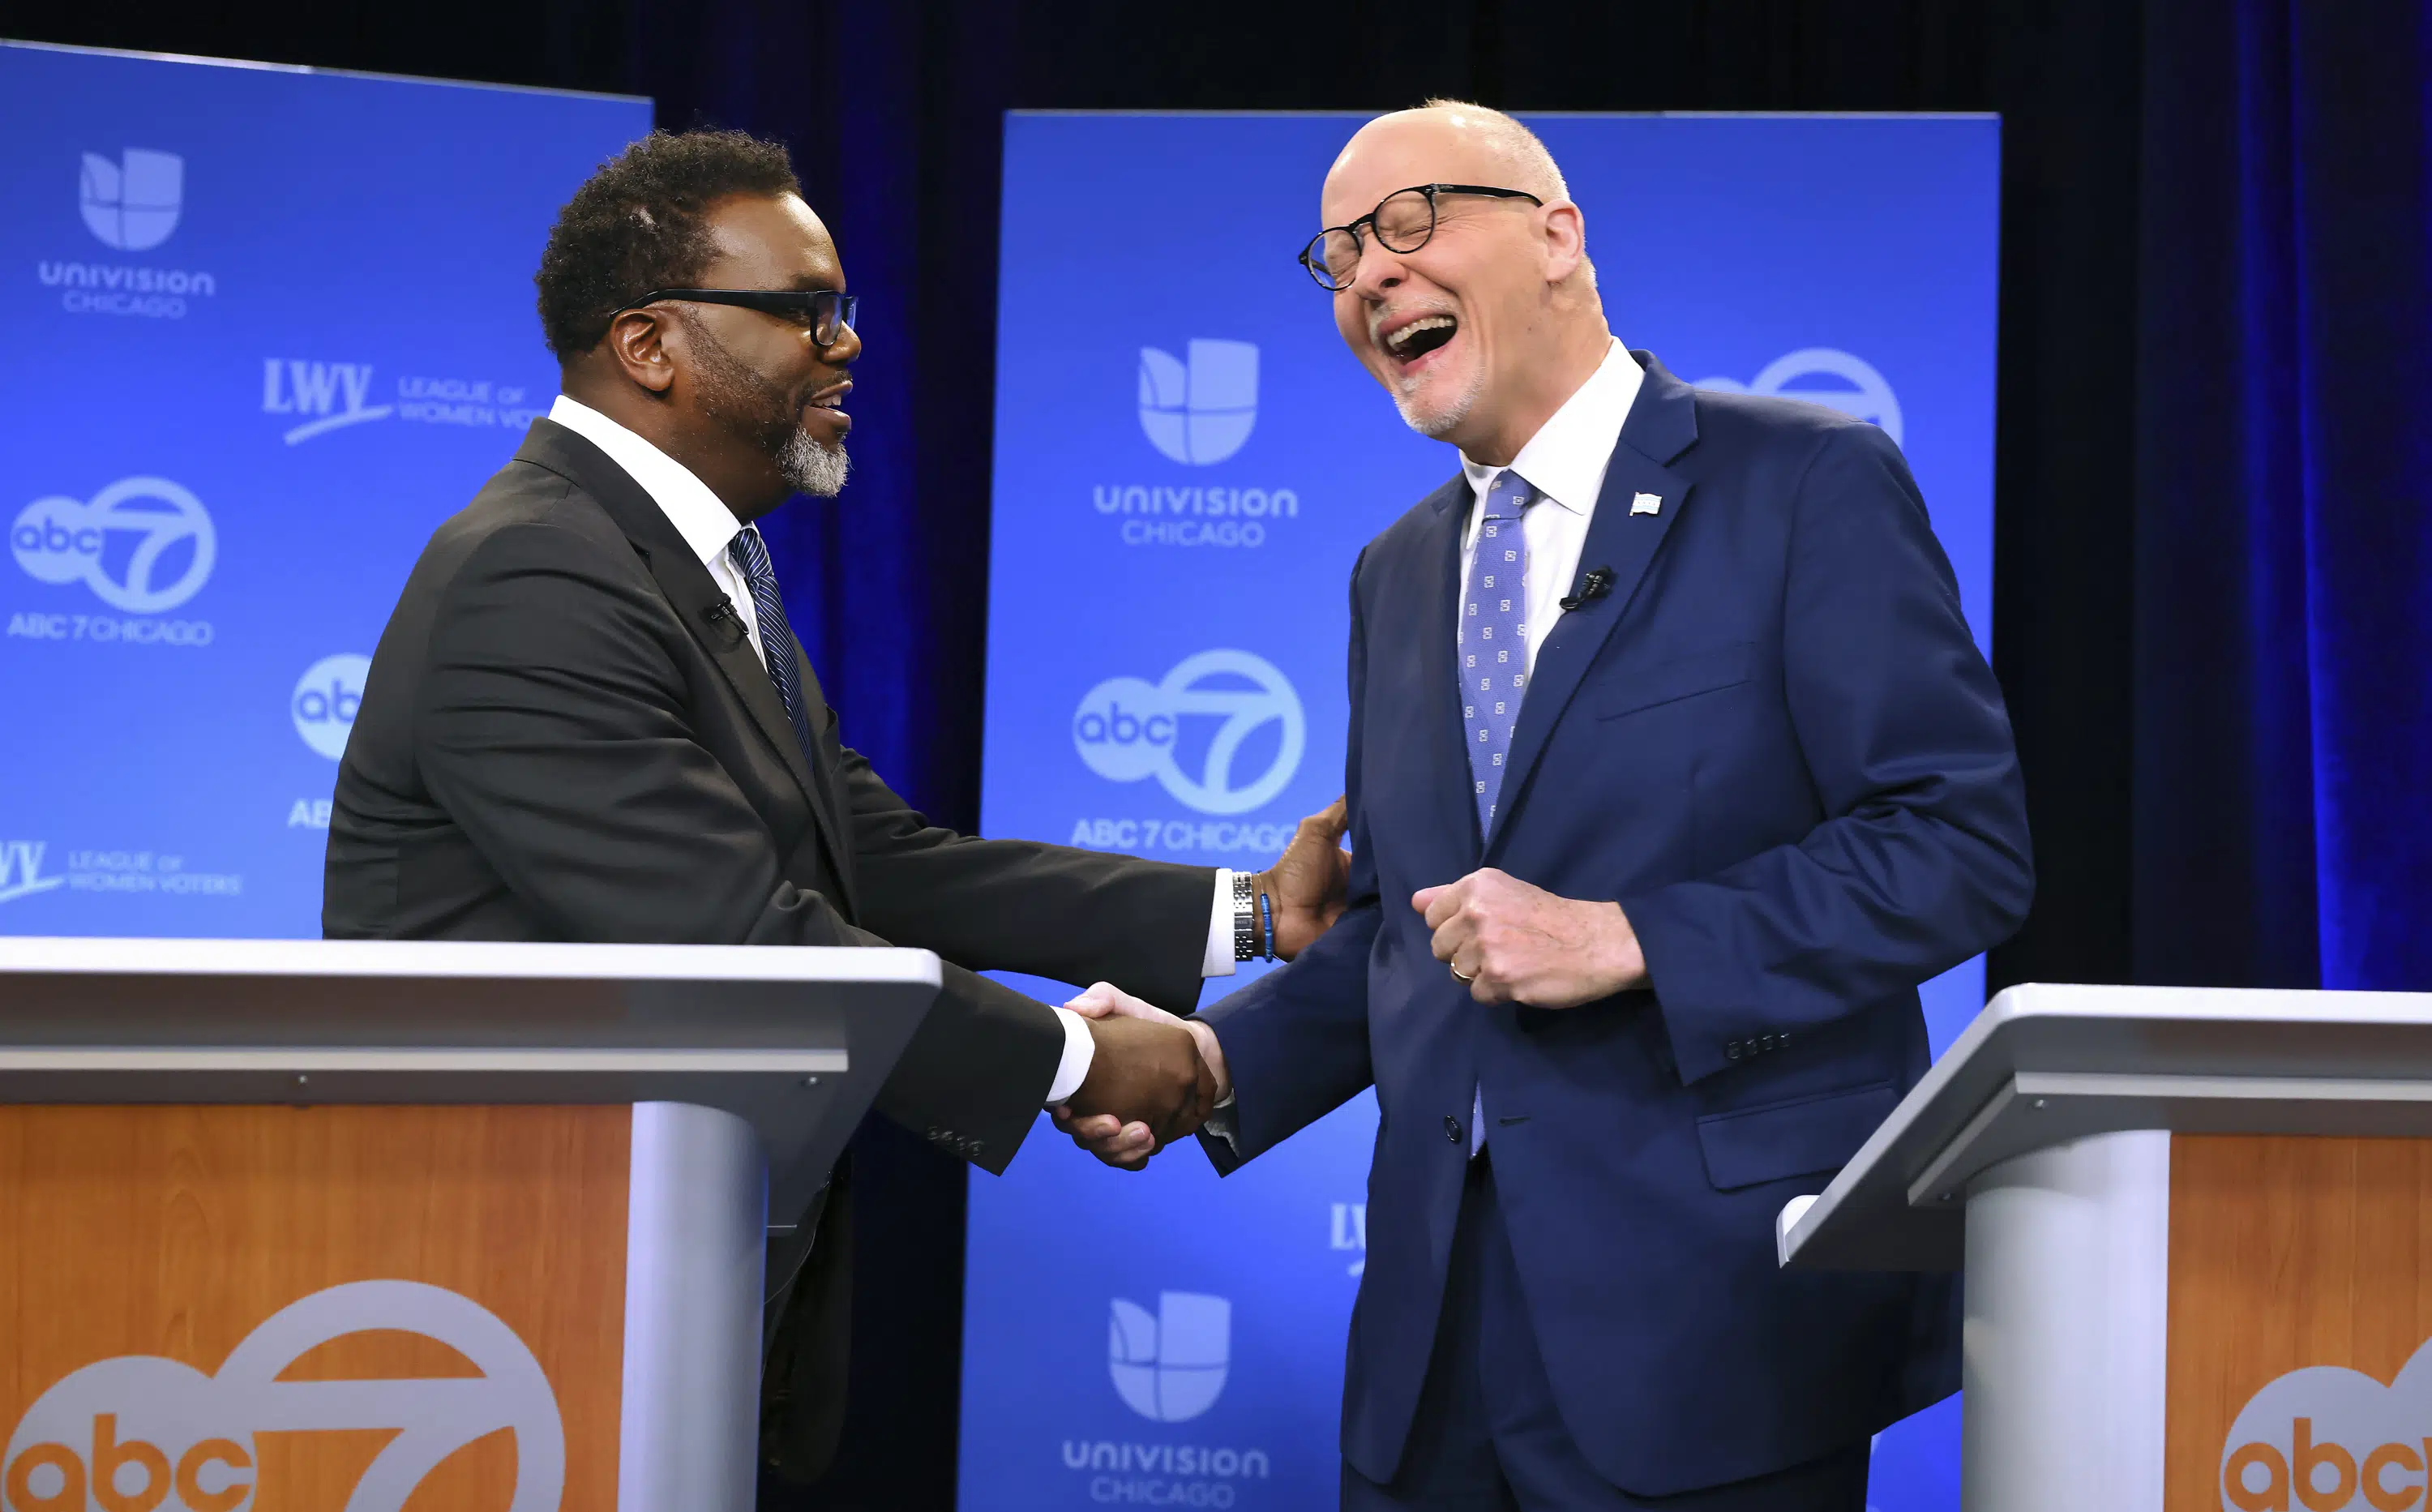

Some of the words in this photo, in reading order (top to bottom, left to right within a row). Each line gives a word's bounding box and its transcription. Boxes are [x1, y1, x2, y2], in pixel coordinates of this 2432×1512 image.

[62, 289, 187, 319] CHICAGO
[263, 357, 374, 416] LWV
[398, 376, 490, 403] LEAGUE
[398, 401, 496, 427] WOMEN
[15, 514, 101, 555] abc
[1121, 520, 1266, 548] CHICAGO
[6, 612, 67, 640] ABC
[299, 678, 361, 722] ab
[1078, 700, 1174, 747] abc
[287, 799, 332, 828] AB
[1071, 818, 1138, 848] ABC
[68, 850, 152, 872] LEAGUE
[68, 872, 156, 893] WOMEN
[161, 873, 242, 895] VOTERS
[4, 1413, 254, 1512] abc
[2224, 1417, 2425, 1512] abc
[1090, 1476, 1235, 1510] CHICAGO
